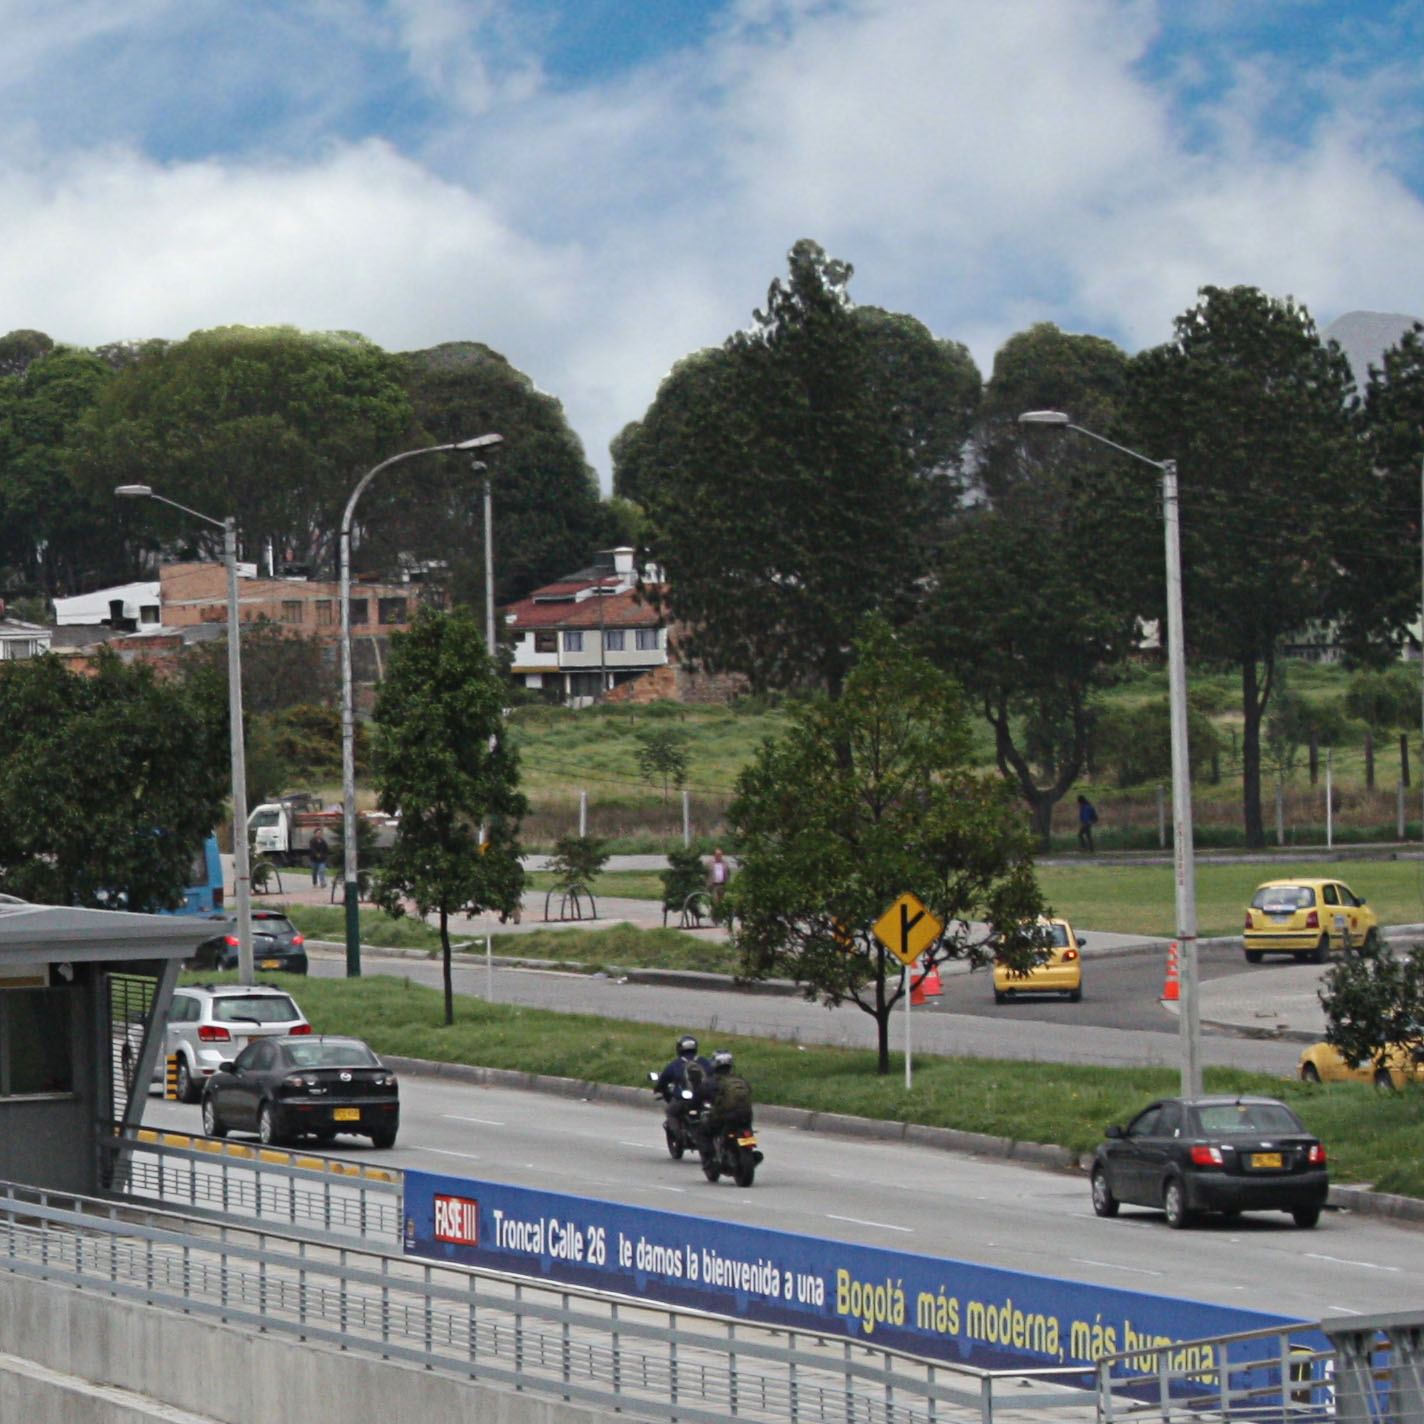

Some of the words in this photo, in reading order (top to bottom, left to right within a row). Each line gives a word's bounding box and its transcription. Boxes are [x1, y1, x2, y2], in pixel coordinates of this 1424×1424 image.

[435, 1198, 463, 1239] FASE
[463, 1204, 476, 1241] III
[493, 1209, 544, 1254] Troncal
[548, 1218, 583, 1261] Calle
[587, 1225, 606, 1266] 26
[618, 1232, 632, 1267] te
[636, 1236, 682, 1277] damos
[687, 1244, 698, 1279] la
[703, 1248, 780, 1297] bienvenida
[784, 1272, 793, 1299] a
[797, 1273, 824, 1306] una
[837, 1268, 904, 1334] Bogotá
[916, 1284, 959, 1334] más
[967, 1299, 1064, 1362] moderna,
[1071, 1313, 1116, 1367] más
